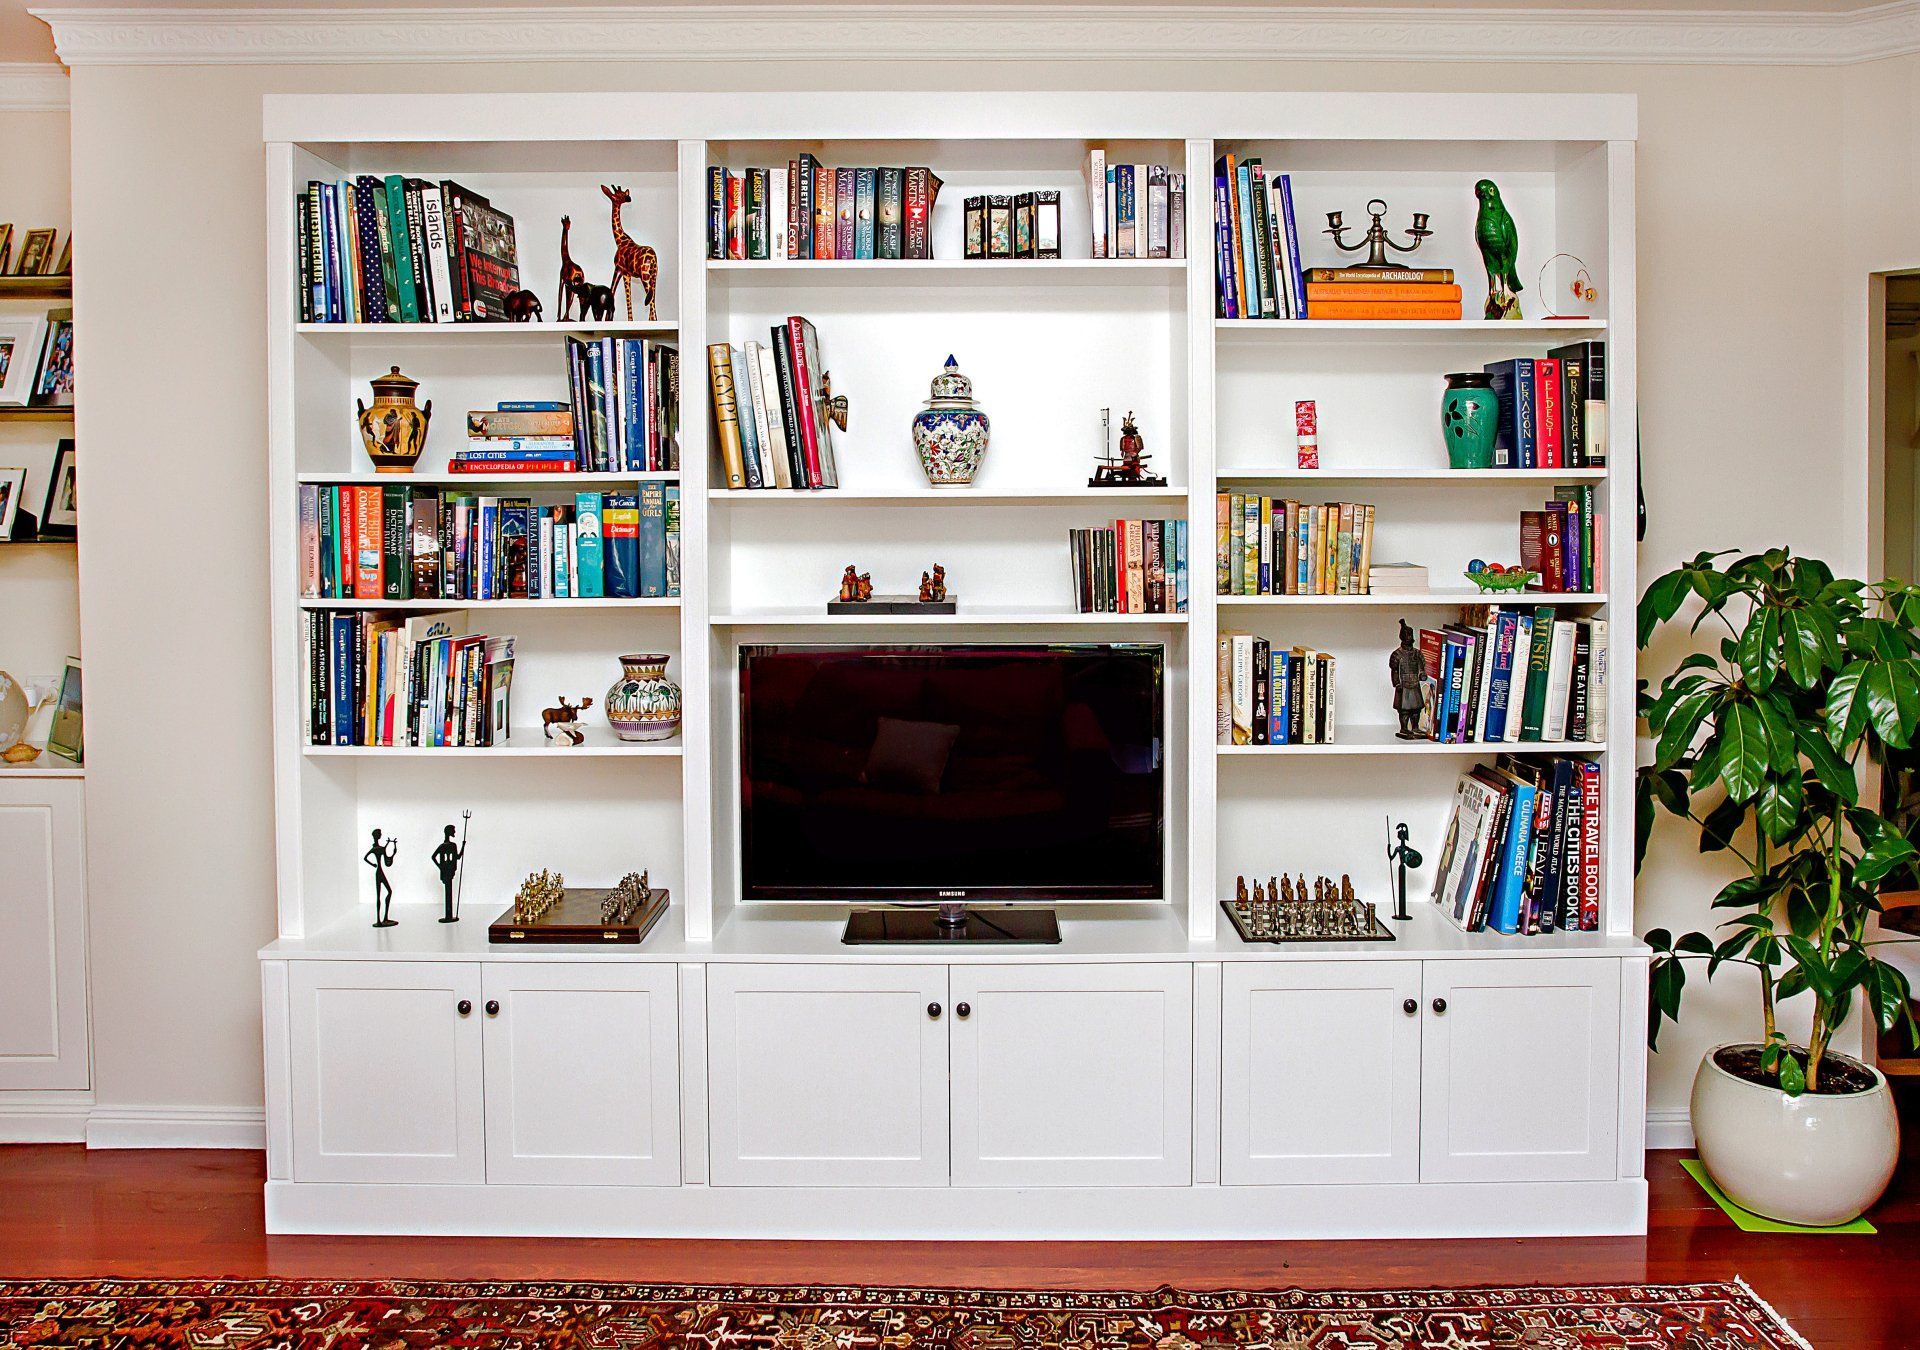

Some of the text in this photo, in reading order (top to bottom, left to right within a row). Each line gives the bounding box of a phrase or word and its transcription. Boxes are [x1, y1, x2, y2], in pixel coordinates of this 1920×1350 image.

[714, 170, 722, 200] LARSSON
[818, 171, 827, 209] MARTIN
[838, 171, 847, 208] MARTIN
[858, 171, 866, 206] MARTIN
[909, 170, 918, 206] MARTIN
[412, 191, 420, 225] COMPLETE
[426, 199, 443, 250] islands
[380, 226, 389, 253] garden
[406, 191, 420, 284] AUSTRALIAN MAMMALS
[789, 222, 798, 250] Leon
[312, 242, 323, 282] RECORDS
[469, 253, 481, 268] We
[471, 268, 486, 286] This
[1382, 271, 1424, 280] ARCHAEOLOGY
[713, 363, 738, 427] EGYPT
[1521, 382, 1531, 438] ERAGON
[1545, 380, 1553, 436] ELDEST
[1570, 379, 1579, 440] BRISINGR
[358, 490, 367, 549] COMMENTARY
[368, 491, 379, 549] NEW BIBLE
[1500, 620, 1516, 669] Adventure
[1530, 617, 1550, 672] MUSIC
[1273, 655, 1282, 716] TRIVIA COLLECTION
[1452, 668, 1463, 689] 1000
[1576, 664, 1585, 719] WEATHER
[1479, 689, 1487, 728] ARRANGING
[1555, 798, 1564, 833] MACQUARIE
[1514, 800, 1530, 876] CULINARIA GREECE
[1552, 834, 1560, 855] WORLD
[1566, 797, 1581, 917] THE CITIES BOOK
[1585, 775, 1599, 908] THE TRAVEL BOOK
[1532, 834, 1549, 896] TRAVEL
